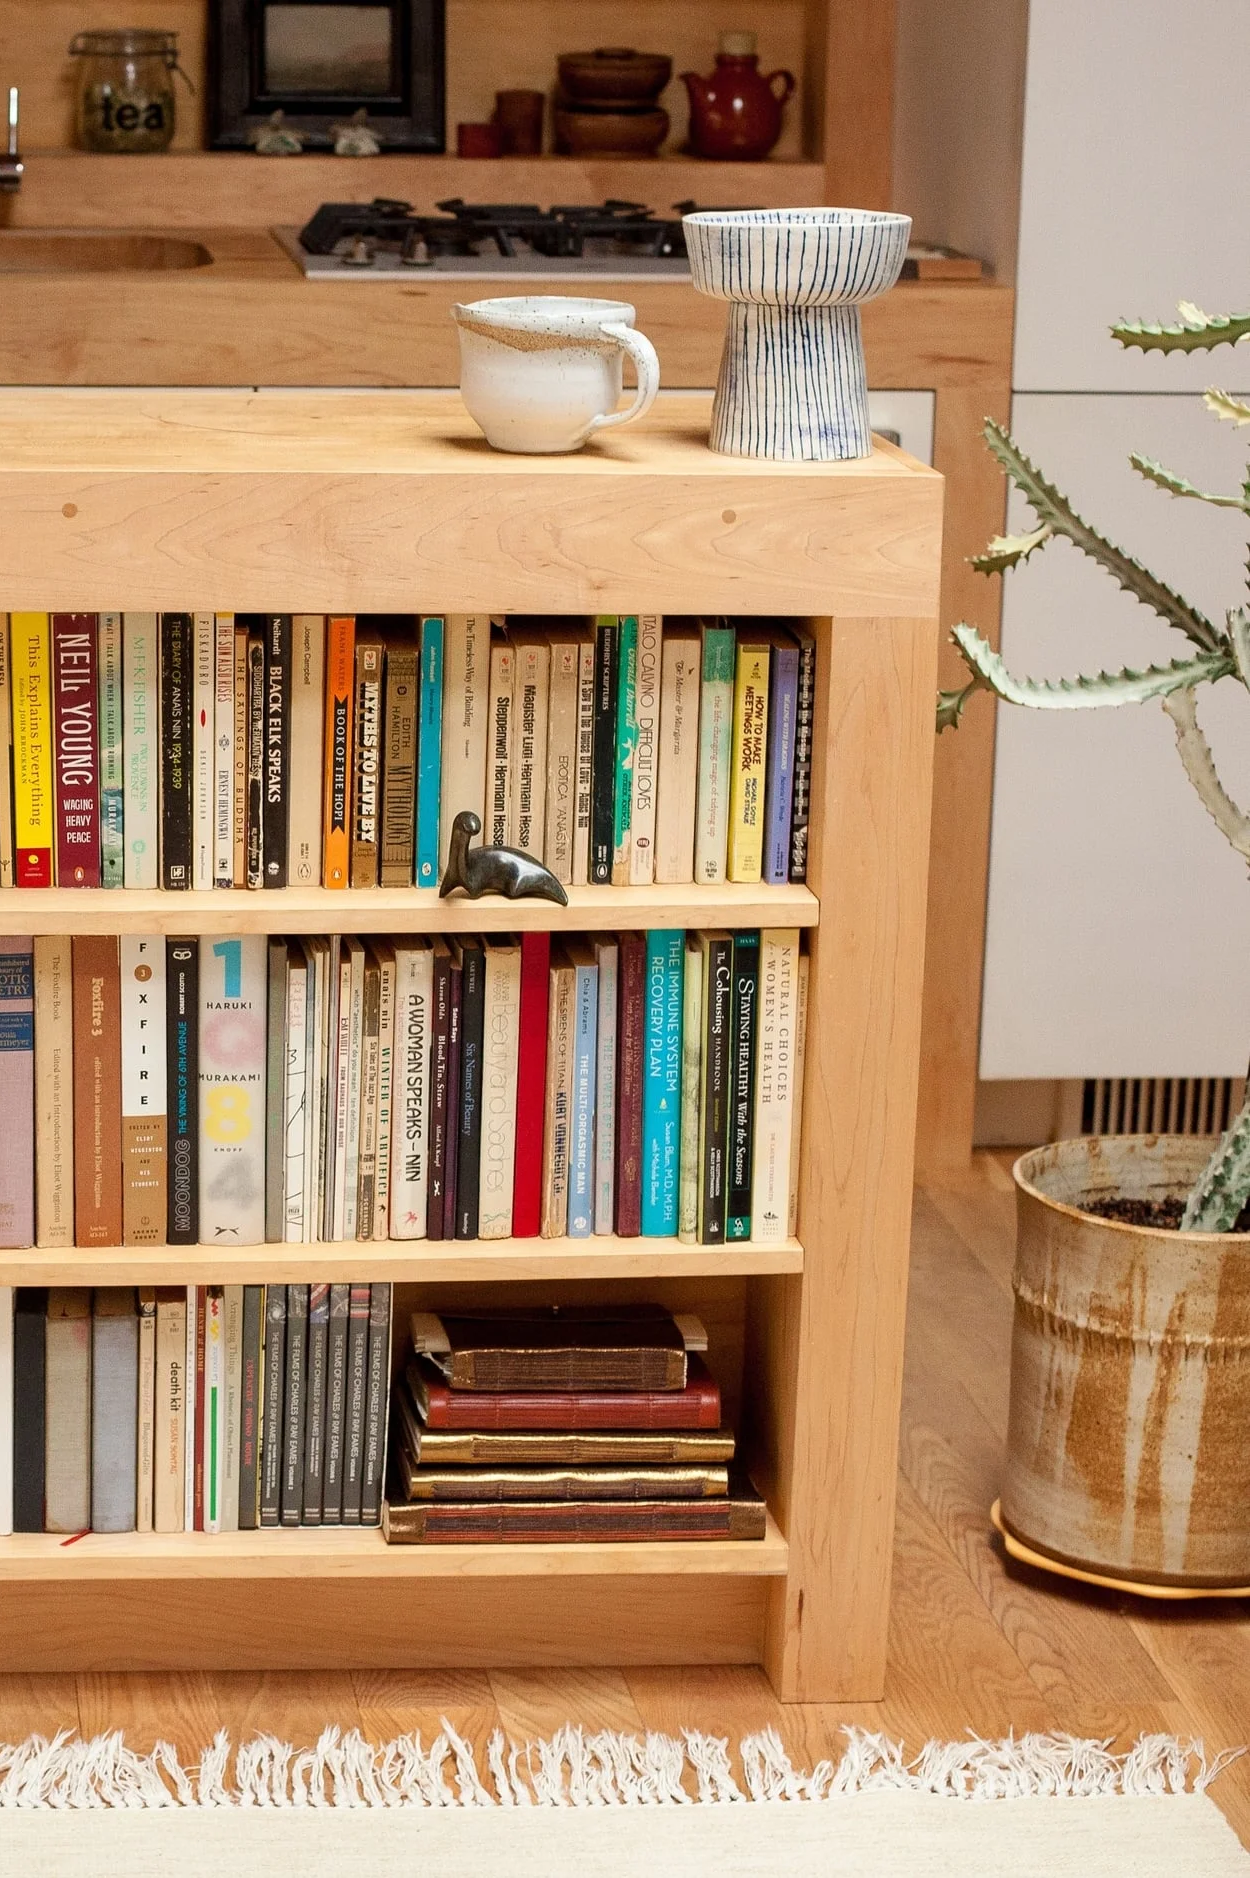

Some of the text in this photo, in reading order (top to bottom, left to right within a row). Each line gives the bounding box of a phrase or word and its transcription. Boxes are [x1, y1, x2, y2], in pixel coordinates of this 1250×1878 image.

[101, 96, 163, 131] tea
[172, 621, 181, 638] THE
[172, 641, 181, 669] DIARY
[172, 671, 182, 684] OF
[463, 619, 475, 727] The Timeless Way of Building
[27, 635, 43, 826] This Explains Everything
[56, 632, 94, 786] NEIL YOUNG
[172, 720, 182, 739] NIN
[268, 619, 282, 803] Neihardt BLACK ELK SPEAKS
[637, 615, 657, 810] ITALO CALVINO DIFFICULT LOVES
[742, 686, 754, 772] MEETINGS WORK
[752, 696, 765, 765] HOW TO MAKE
[169, 742, 183, 789] 1934-1939
[334, 708, 345, 821] BOOK OF THE HOPI
[492, 697, 510, 846] Steppenwolf Hermann Hesse
[63, 799, 93, 810] WAGING
[66, 815, 91, 827] HEAVY
[386, 765, 412, 848] MYTHOLOGY
[67, 832, 91, 843] PEACE
[716, 951, 726, 965] The
[207, 1002, 251, 1010] HARUKI
[650, 956, 664, 1077] RECOVERY PLAN
[666, 938, 680, 1092] THE IMMUNE SYSTEM
[712, 966, 730, 1034] Cohousing
[200, 1074, 260, 1082] MURAKAMI
[405, 994, 424, 1182] A WOMAN SPEAKS NIN
[461, 1043, 475, 1136] Six Names of Beauty
[735, 978, 755, 1185] STAYING HEALTHY With the Seasons
[175, 1140, 191, 1231] MOONDOG
[371, 1350, 381, 1371] FILMS
[373, 1336, 382, 1349] THE
[170, 1362, 182, 1411] death kit
[370, 1382, 380, 1413] CHARLES
[371, 1371, 380, 1381] OF
[368, 1422, 378, 1437] RAY
[368, 1437, 377, 1461] EAMES
